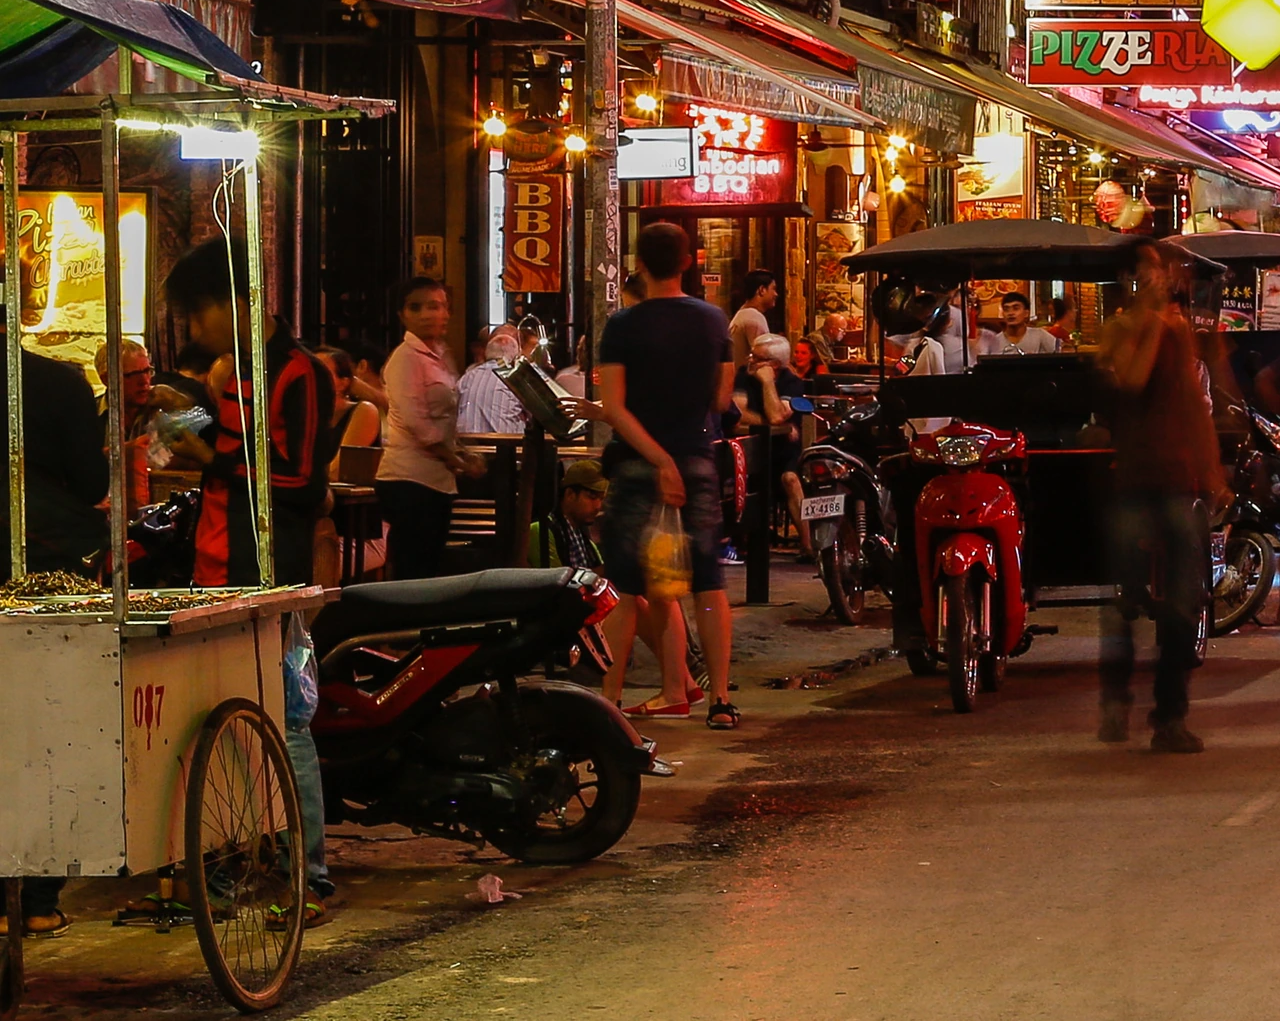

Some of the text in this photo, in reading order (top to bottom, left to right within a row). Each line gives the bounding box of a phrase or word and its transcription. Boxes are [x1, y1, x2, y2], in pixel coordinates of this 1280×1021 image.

[1031, 30, 1227, 75] PIZZERIA
[699, 156, 780, 176] mbodian
[513, 182, 552, 266] BBQ
